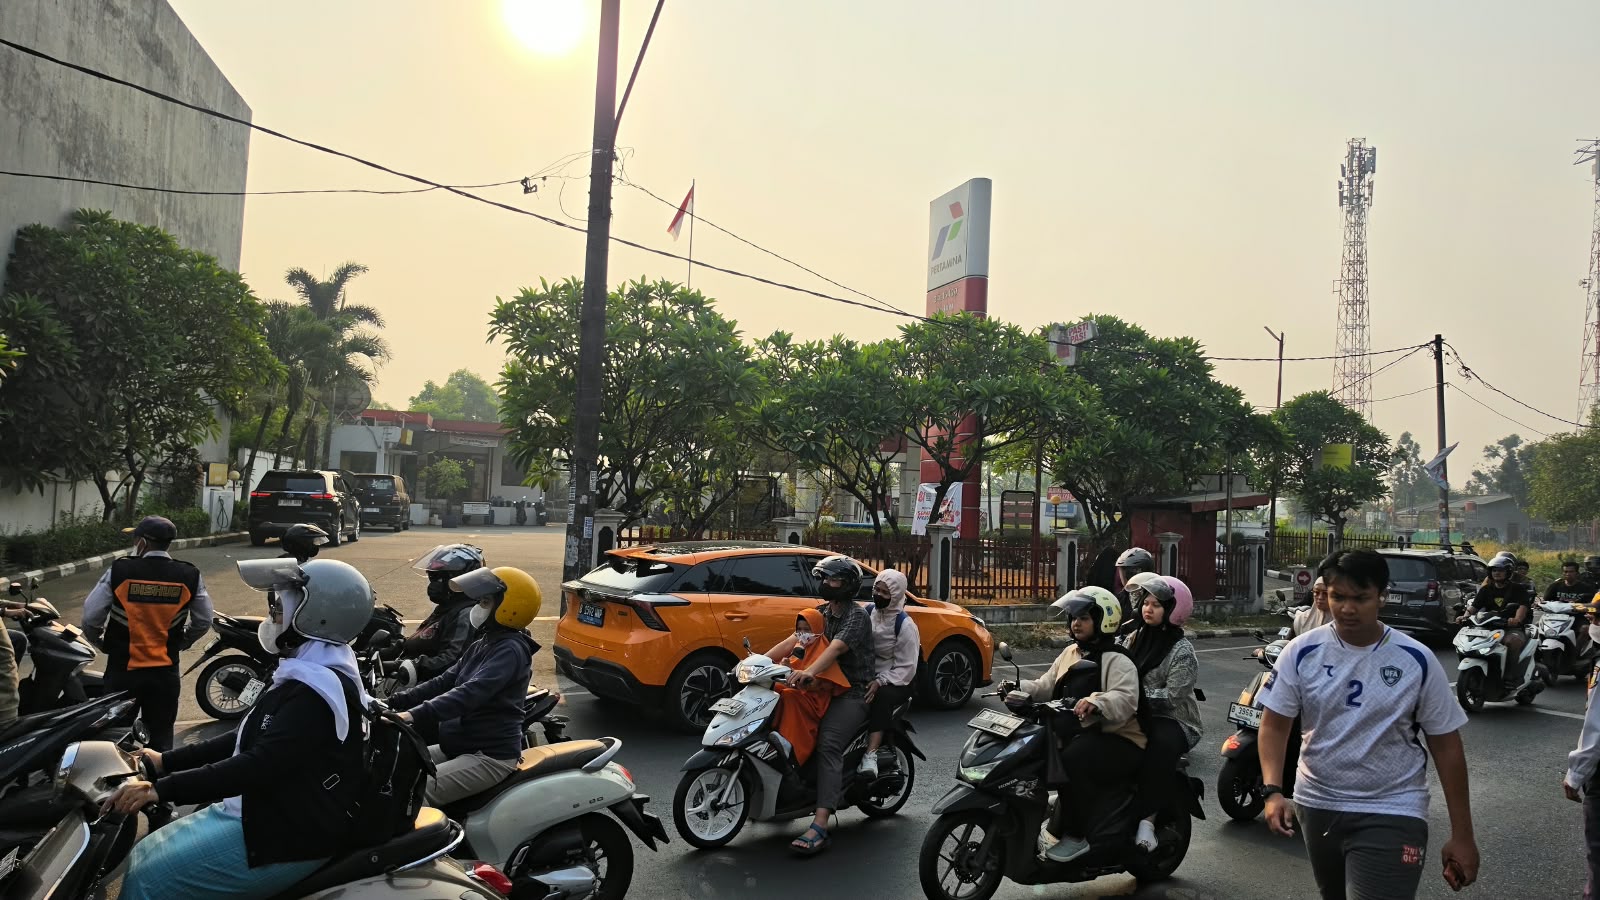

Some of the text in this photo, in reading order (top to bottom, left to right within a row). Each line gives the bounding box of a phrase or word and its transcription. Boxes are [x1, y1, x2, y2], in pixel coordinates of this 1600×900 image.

[930, 253, 962, 276] PERTAMINA
[1068, 322, 1088, 337] PASTI
[1384, 670, 1398, 678] UFA
[1346, 679, 1363, 707] 2
